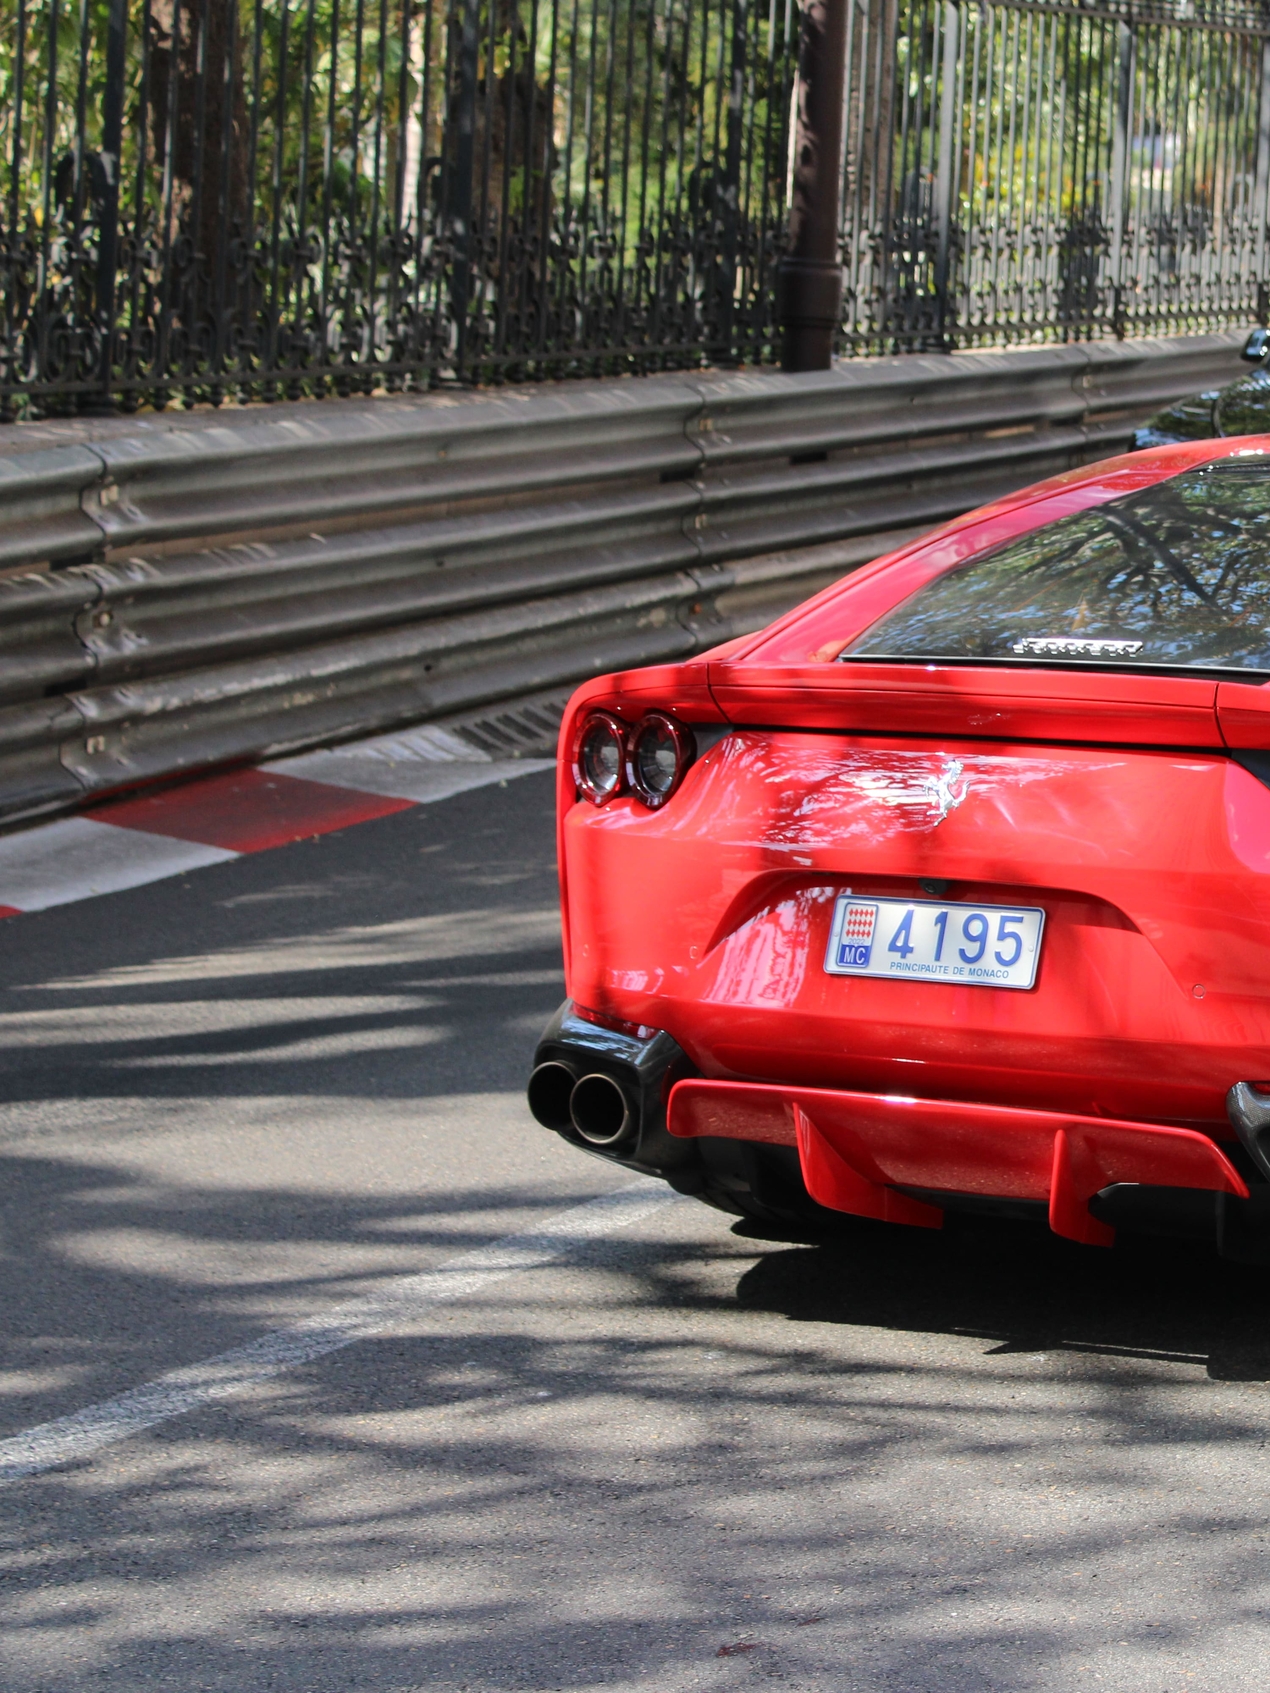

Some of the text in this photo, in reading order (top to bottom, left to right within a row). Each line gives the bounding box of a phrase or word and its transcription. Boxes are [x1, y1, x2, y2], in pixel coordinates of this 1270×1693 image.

[887, 908, 1025, 968] 4195
[843, 946, 867, 964] MC
[889, 961, 1010, 979] PRINCIPAUTE DE MONACO
